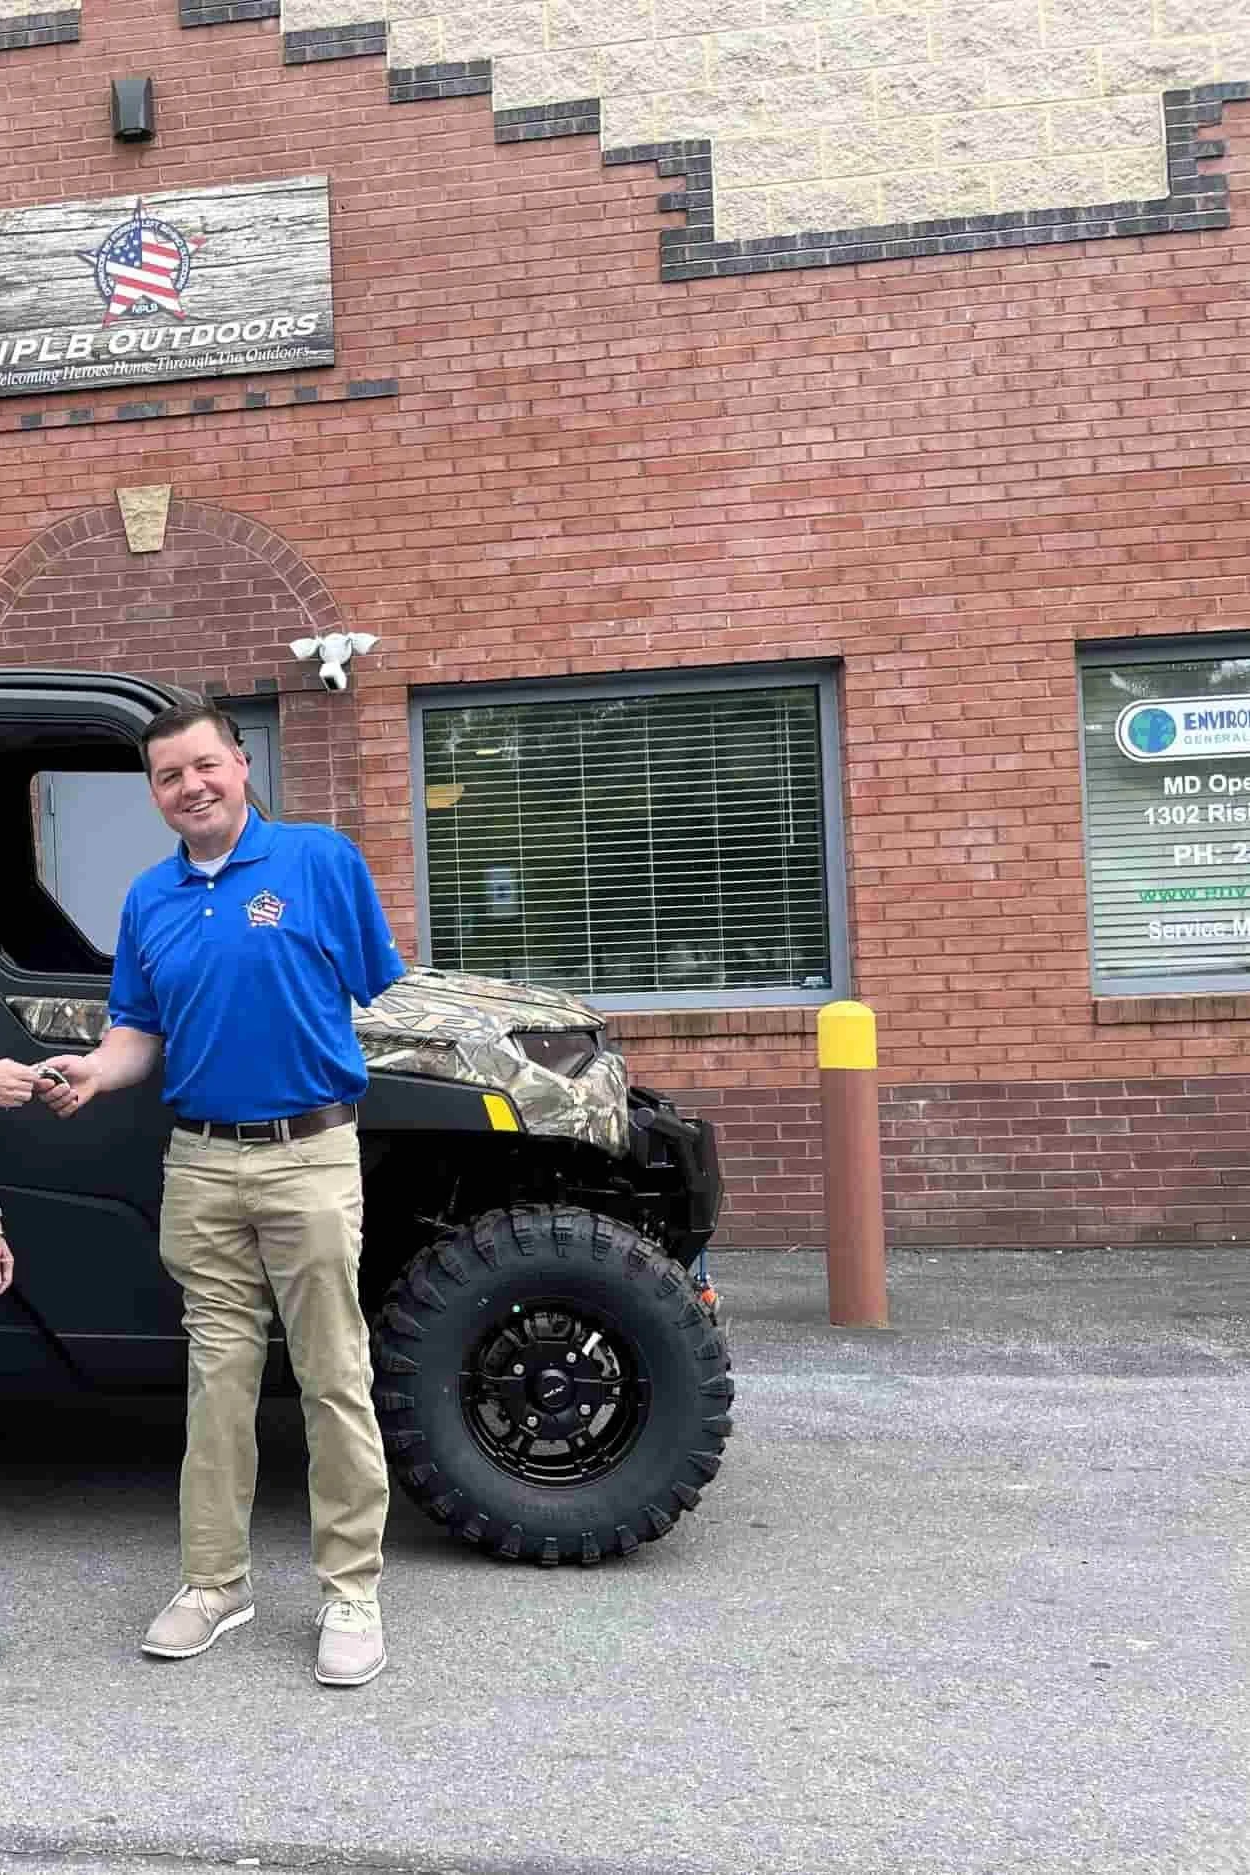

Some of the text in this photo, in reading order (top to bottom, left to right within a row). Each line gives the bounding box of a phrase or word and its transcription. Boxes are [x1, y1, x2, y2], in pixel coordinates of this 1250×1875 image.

[109, 312, 322, 354] OUTDOORS
[158, 353, 215, 371] Through
[245, 345, 310, 362] Outdoors
[1183, 709, 1250, 730] ENVIRO
[1163, 775, 1201, 795] MD
[1143, 805, 1199, 825] 1302
[1174, 844, 1223, 866] PH:
[1150, 919, 1223, 940] Service
